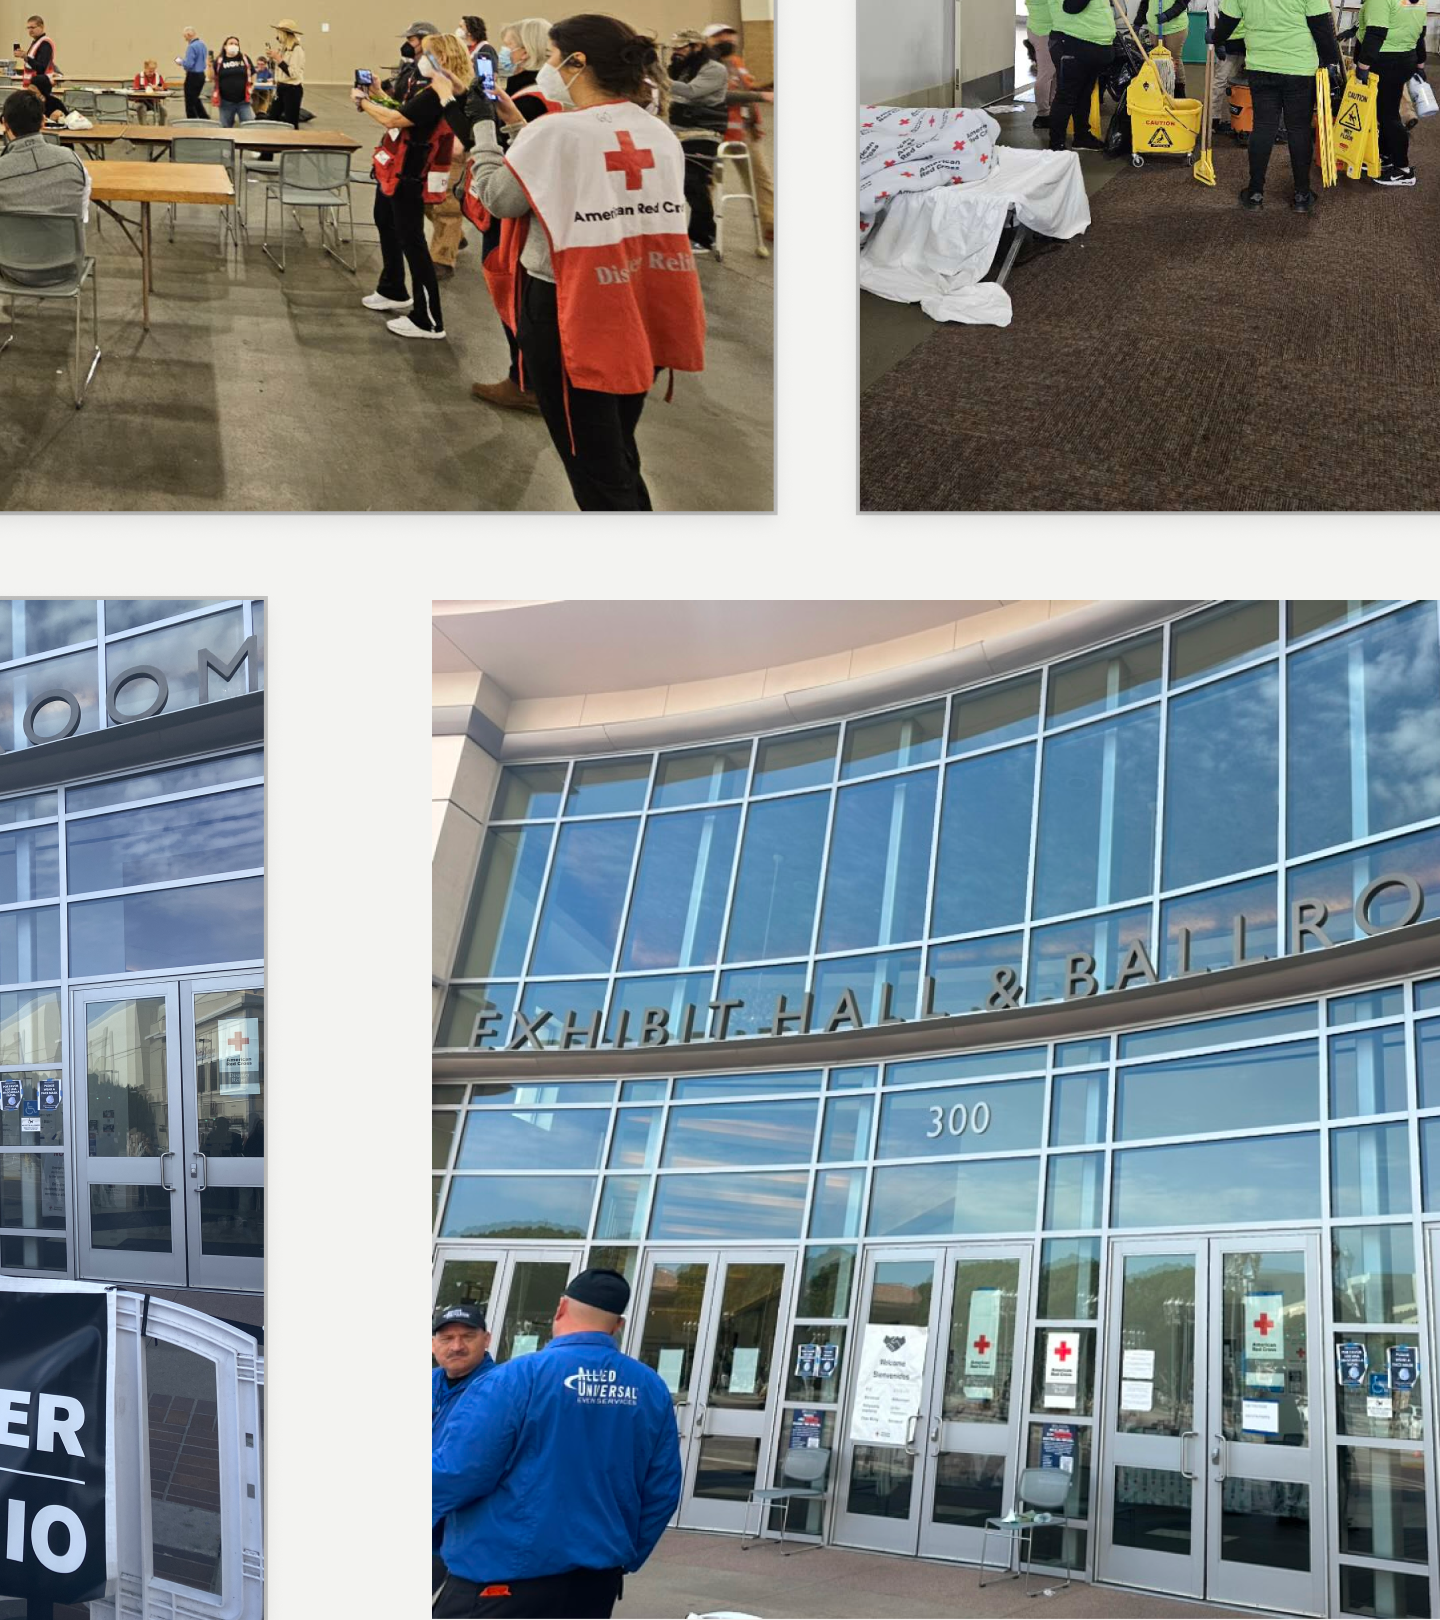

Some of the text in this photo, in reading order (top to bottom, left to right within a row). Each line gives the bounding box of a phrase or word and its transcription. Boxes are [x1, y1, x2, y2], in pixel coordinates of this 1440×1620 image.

[1347, 90, 1369, 104] CAUTION
[1145, 119, 1176, 127] CAUTION
[470, 998, 746, 1051] EXHIBIT
[771, 974, 950, 1038] HALL
[984, 964, 1027, 1011] &
[226, 1056, 253, 1064] American
[926, 1100, 991, 1139] 300
[577, 1366, 617, 1383] ALLIED
[577, 1382, 638, 1400] UNIVERSAL
